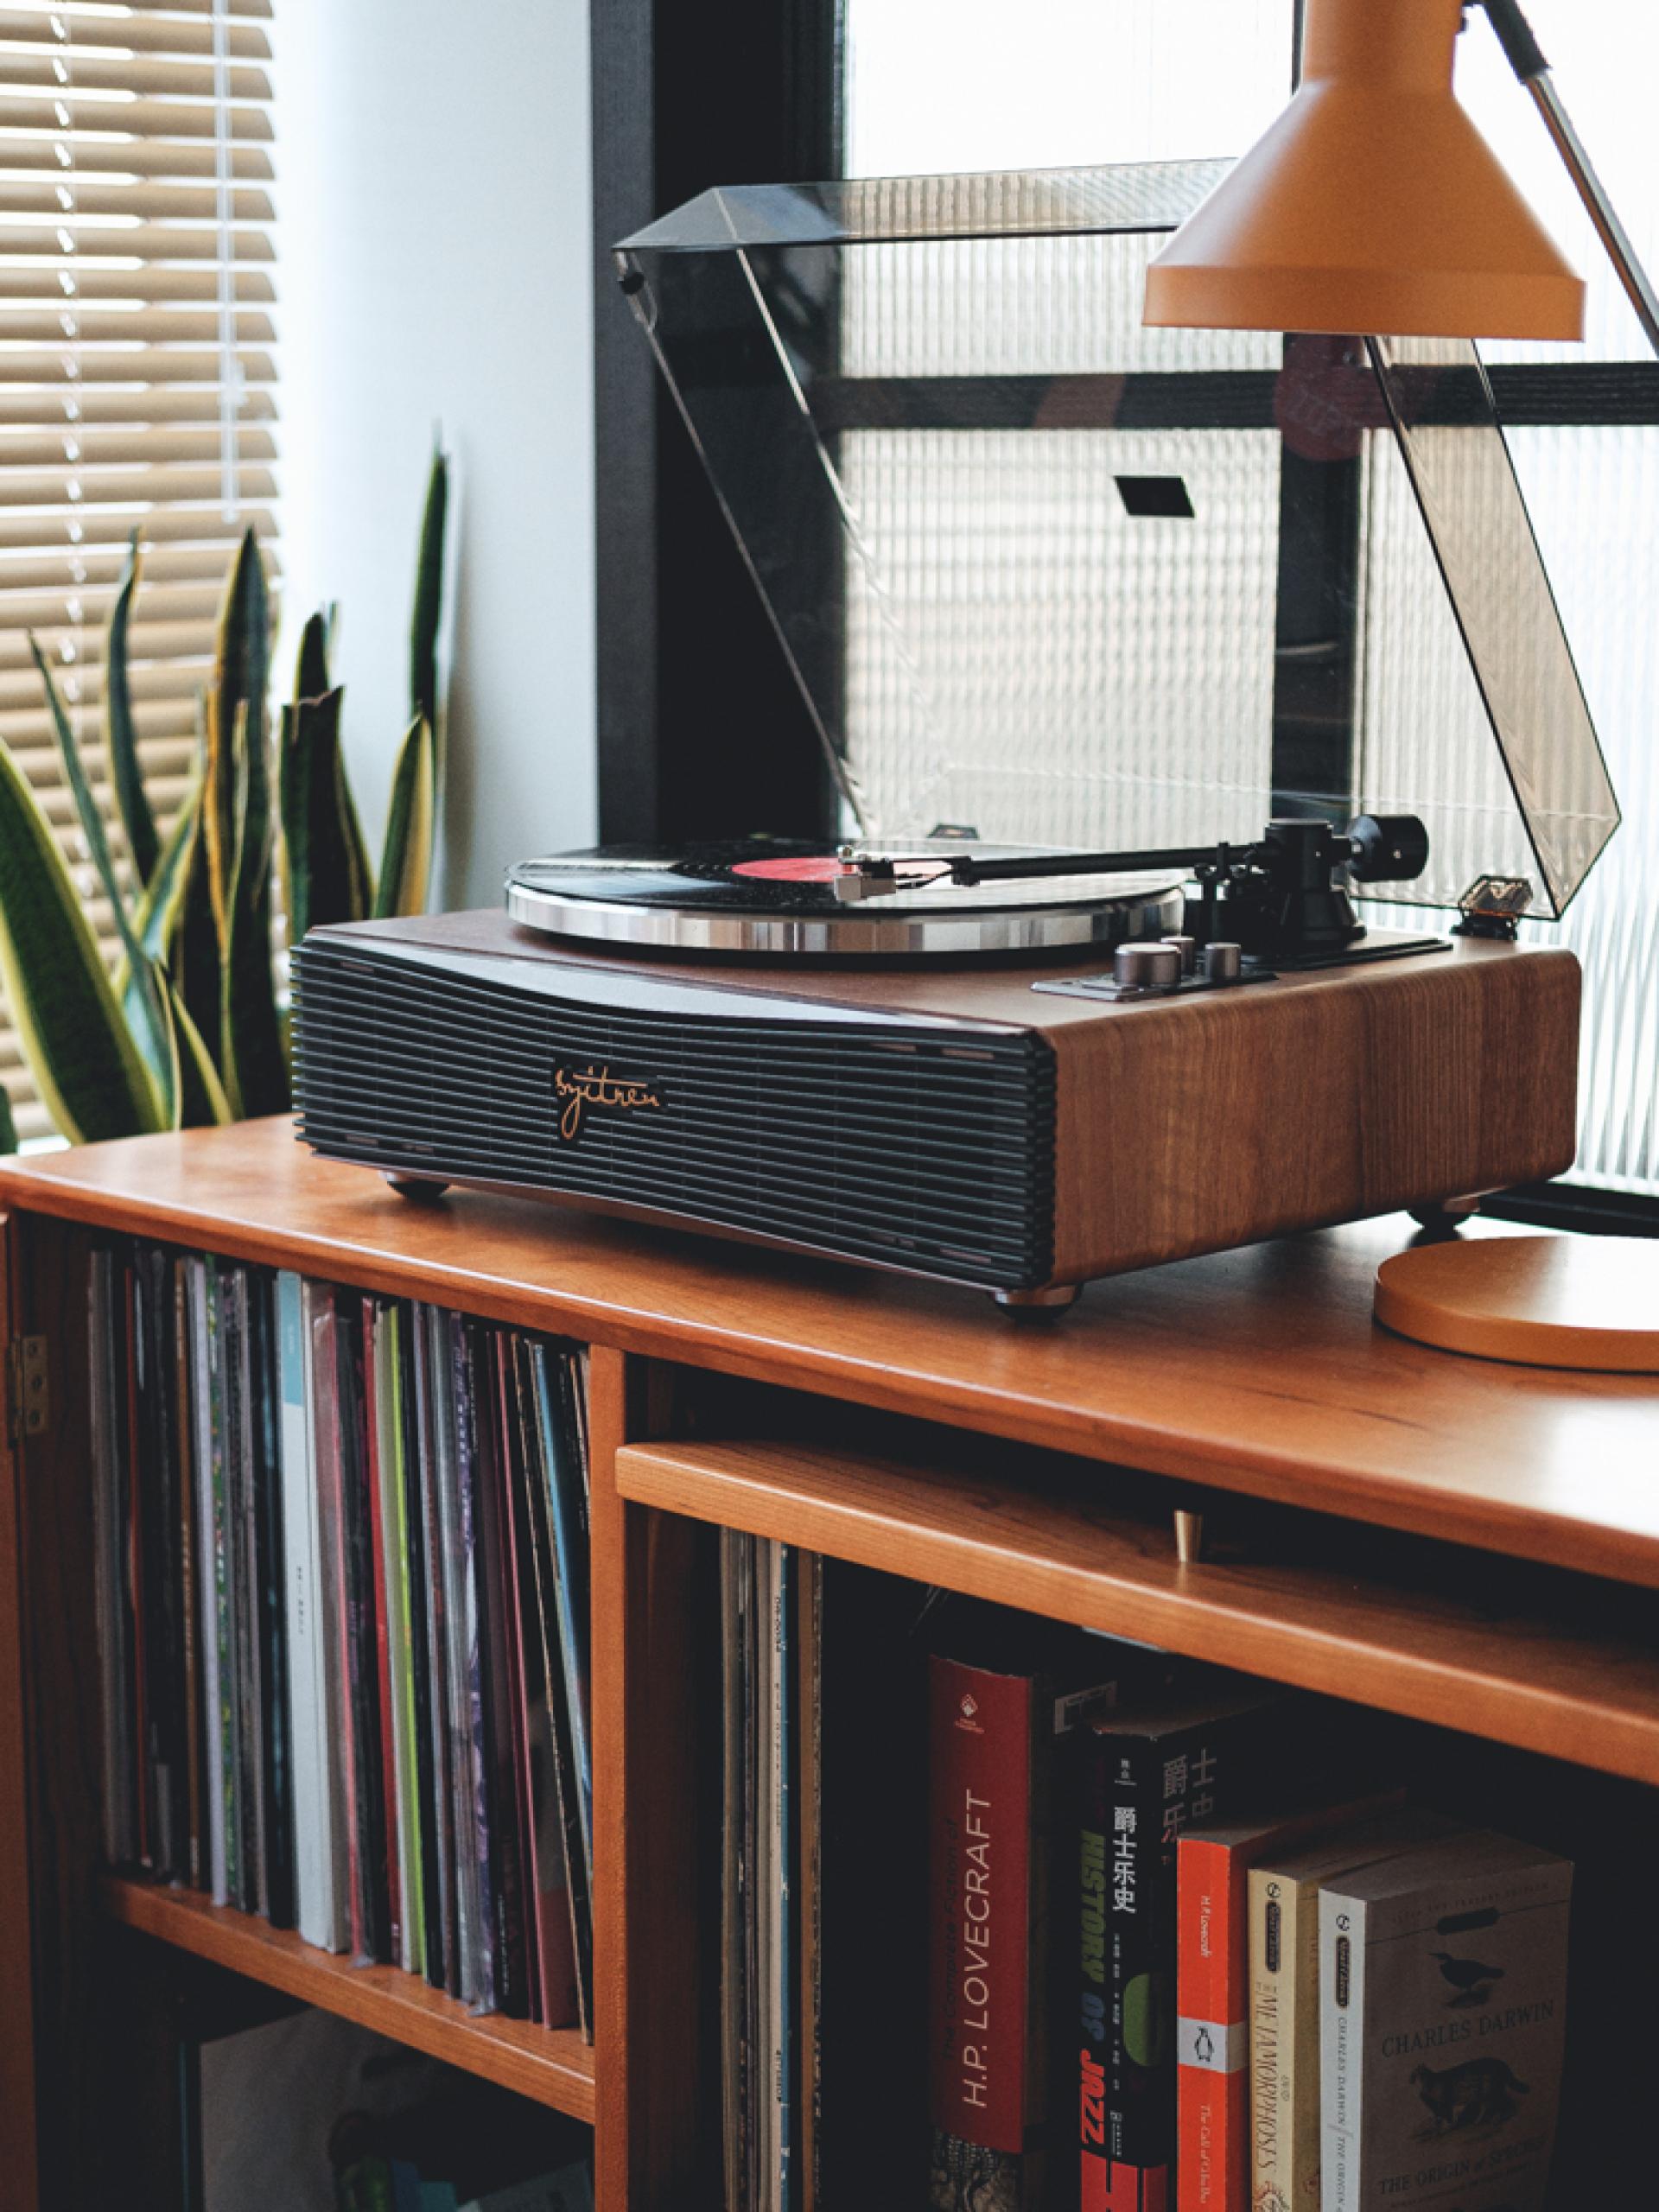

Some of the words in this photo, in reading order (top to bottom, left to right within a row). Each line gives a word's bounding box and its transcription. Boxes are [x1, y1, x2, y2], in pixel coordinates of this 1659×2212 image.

[963, 1789, 992, 2030] LOVECRAFT
[1080, 1828, 1106, 1985] HISTORY
[943, 1922, 958, 2018] Complete
[1080, 1992, 1105, 2042] OF
[1338, 2016, 1348, 2072] CHARLES
[1382, 2016, 1472, 2058] CHARLES
[1478, 1998, 1554, 2037] DARWIN
[962, 2044, 988, 2108] H.P.
[1080, 2048, 1106, 2146] JAZZ
[1337, 2075, 1347, 2126] DARWIN
[1380, 2173, 1410, 2195] THE
